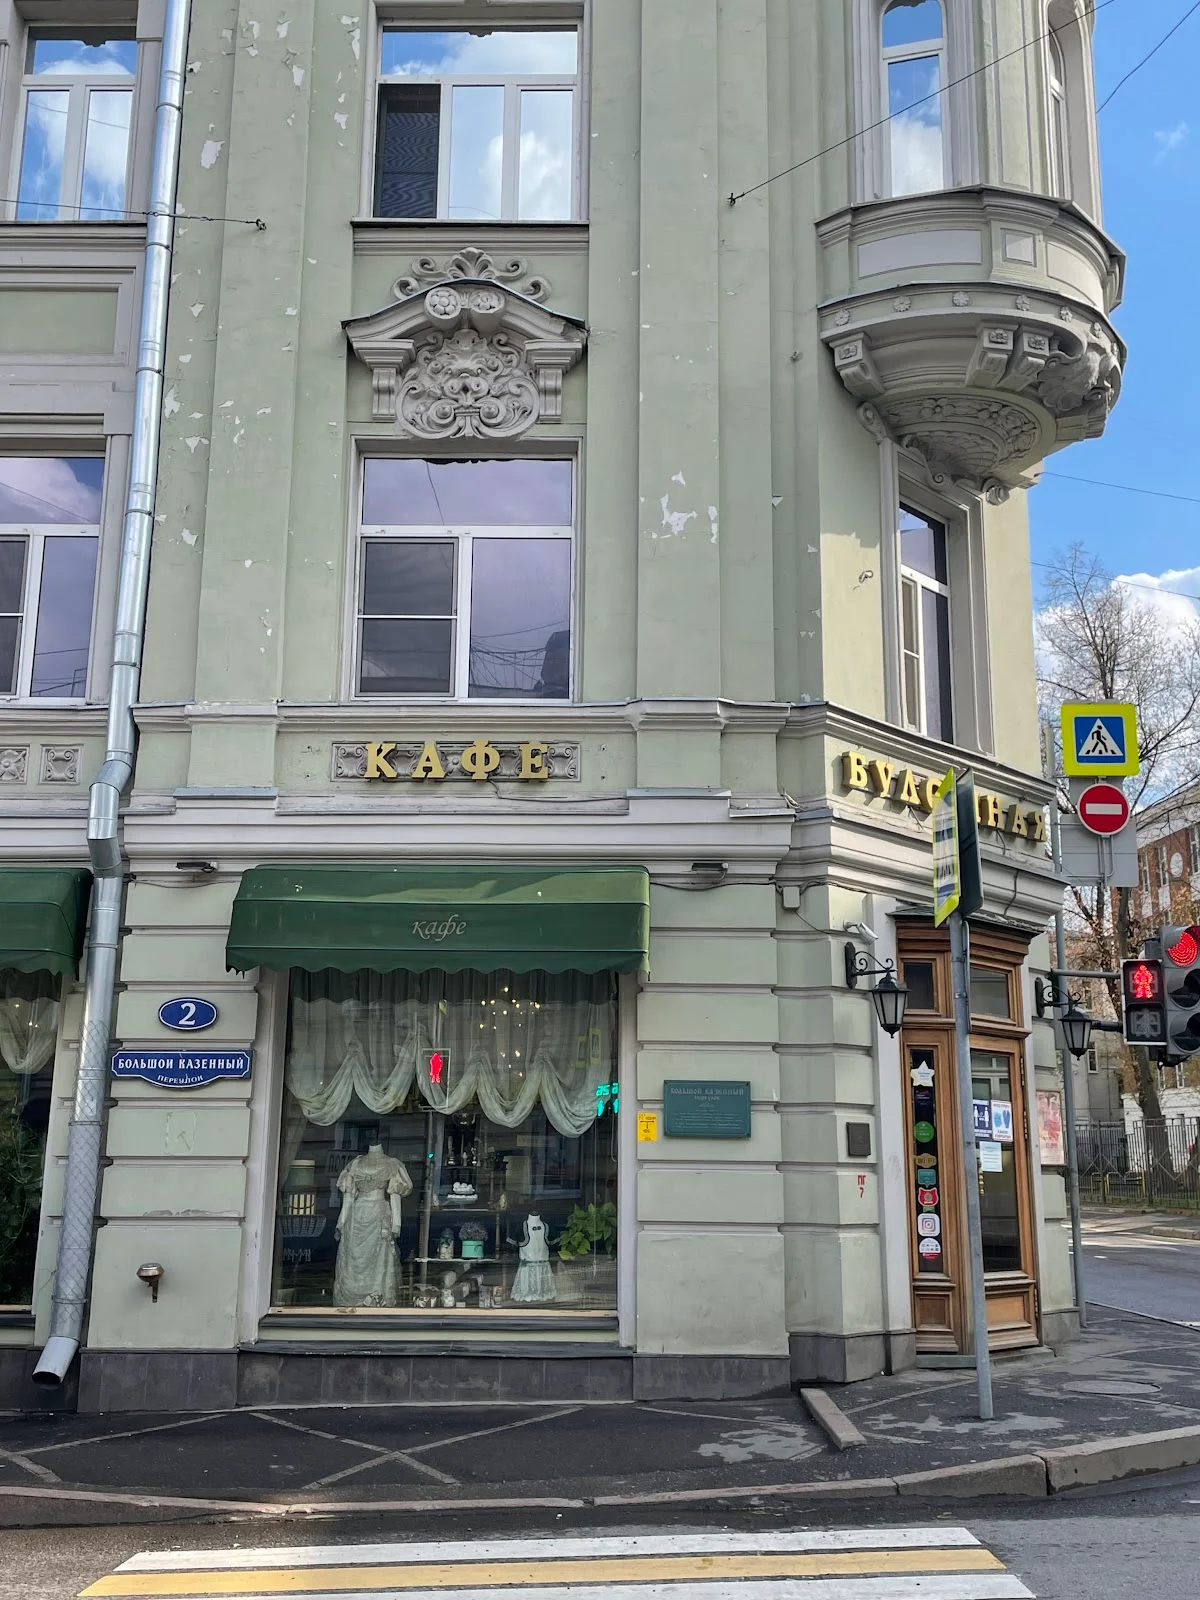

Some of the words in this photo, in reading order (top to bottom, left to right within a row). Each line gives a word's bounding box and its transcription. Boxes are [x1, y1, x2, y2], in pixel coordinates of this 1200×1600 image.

[364, 740, 550, 781] КАФЕ
[412, 914, 467, 941] кафе
[178, 1002, 197, 1025] 2
[178, 1056, 244, 1069] КАЗЕННЫЙ
